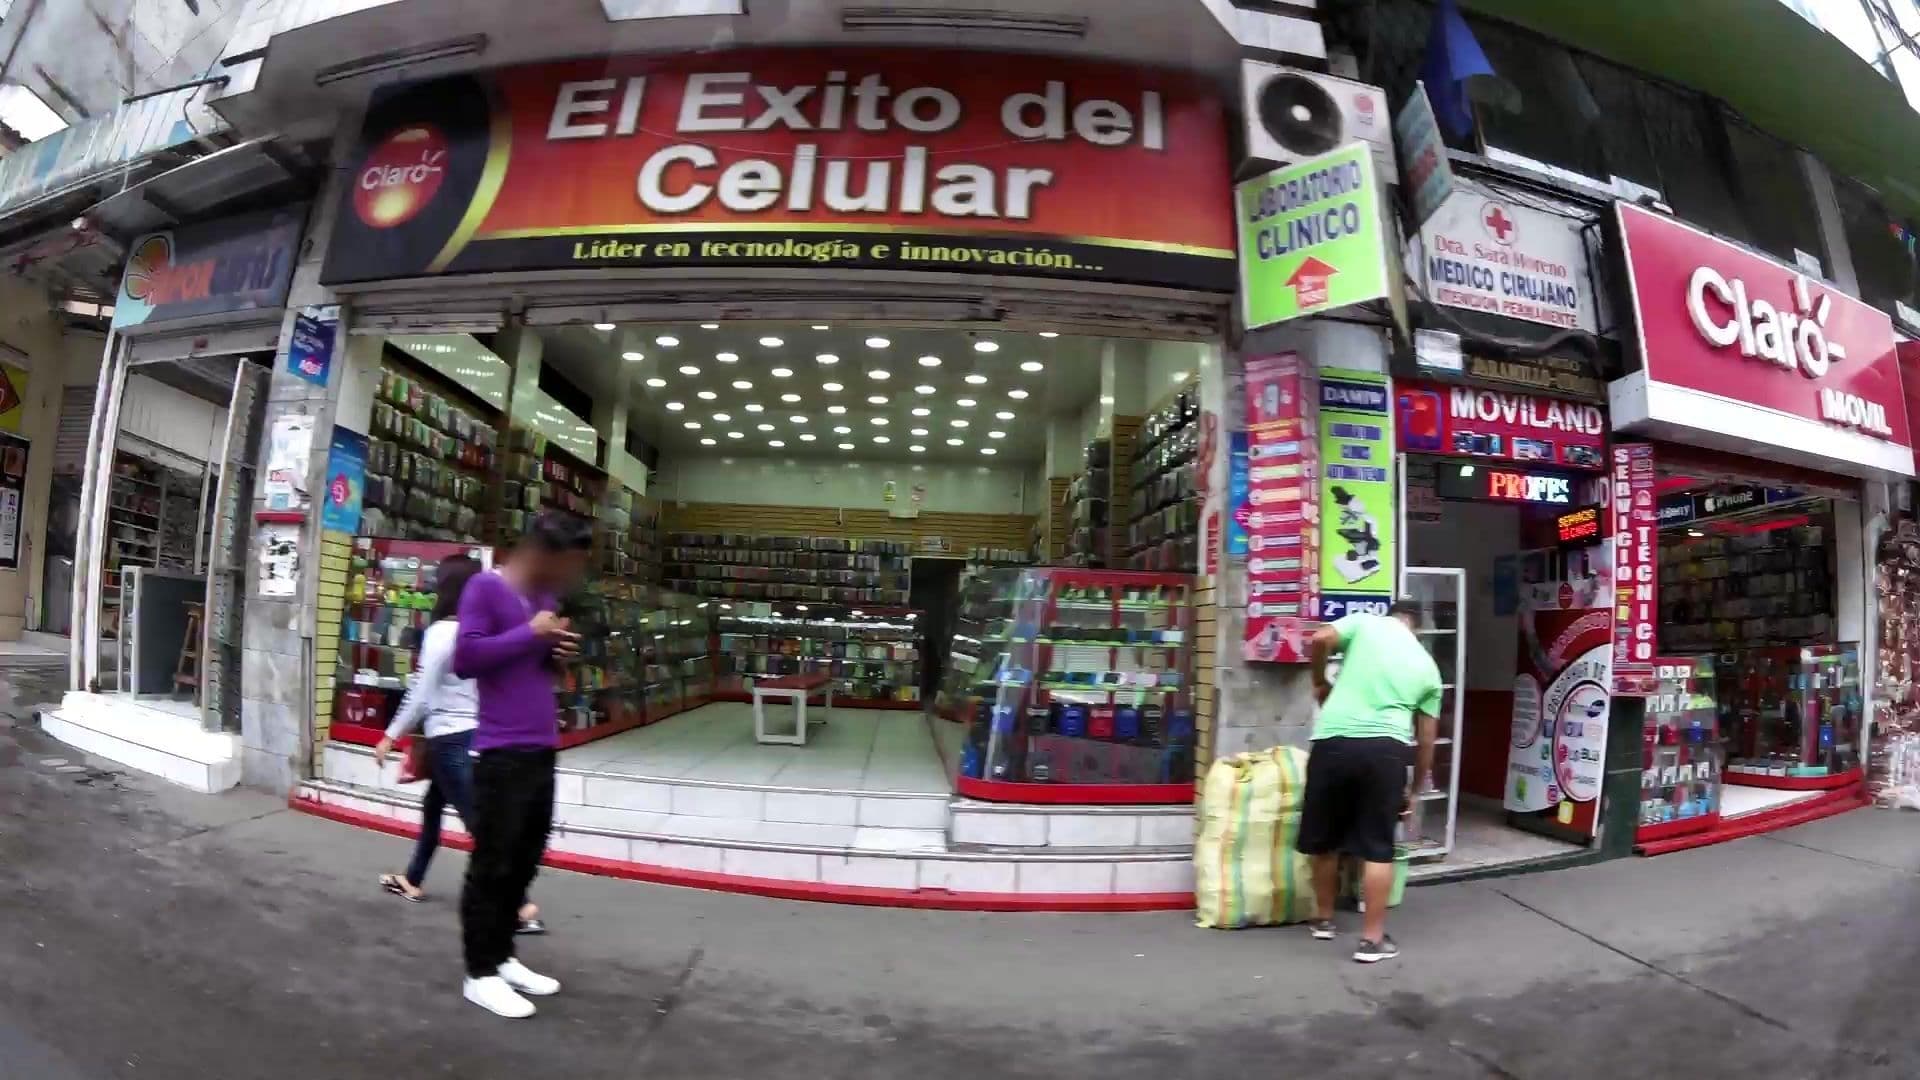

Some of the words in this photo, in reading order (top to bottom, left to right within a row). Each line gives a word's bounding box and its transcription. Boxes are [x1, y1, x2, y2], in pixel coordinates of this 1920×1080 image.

[546, 76, 646, 140] El
[677, 71, 961, 133] Exito
[1001, 80, 1164, 150] del
[361, 158, 433, 190] Claro
[637, 144, 1054, 219] Celular
[573, 240, 645, 260] Líder
[655, 241, 690, 258] en
[701, 238, 860, 263] tecnología
[871, 244, 890, 260] e
[1257, 202, 1360, 263] CLINICO
[1430, 256, 1494, 292] MEDICO
[1501, 272, 1576, 309] CIRUJANO
[1687, 266, 1834, 377] Claro
[1451, 387, 1603, 435] MOVILAND
[1821, 387, 1892, 435] MOVIL
[1615, 448, 1632, 581] SERVICIO
